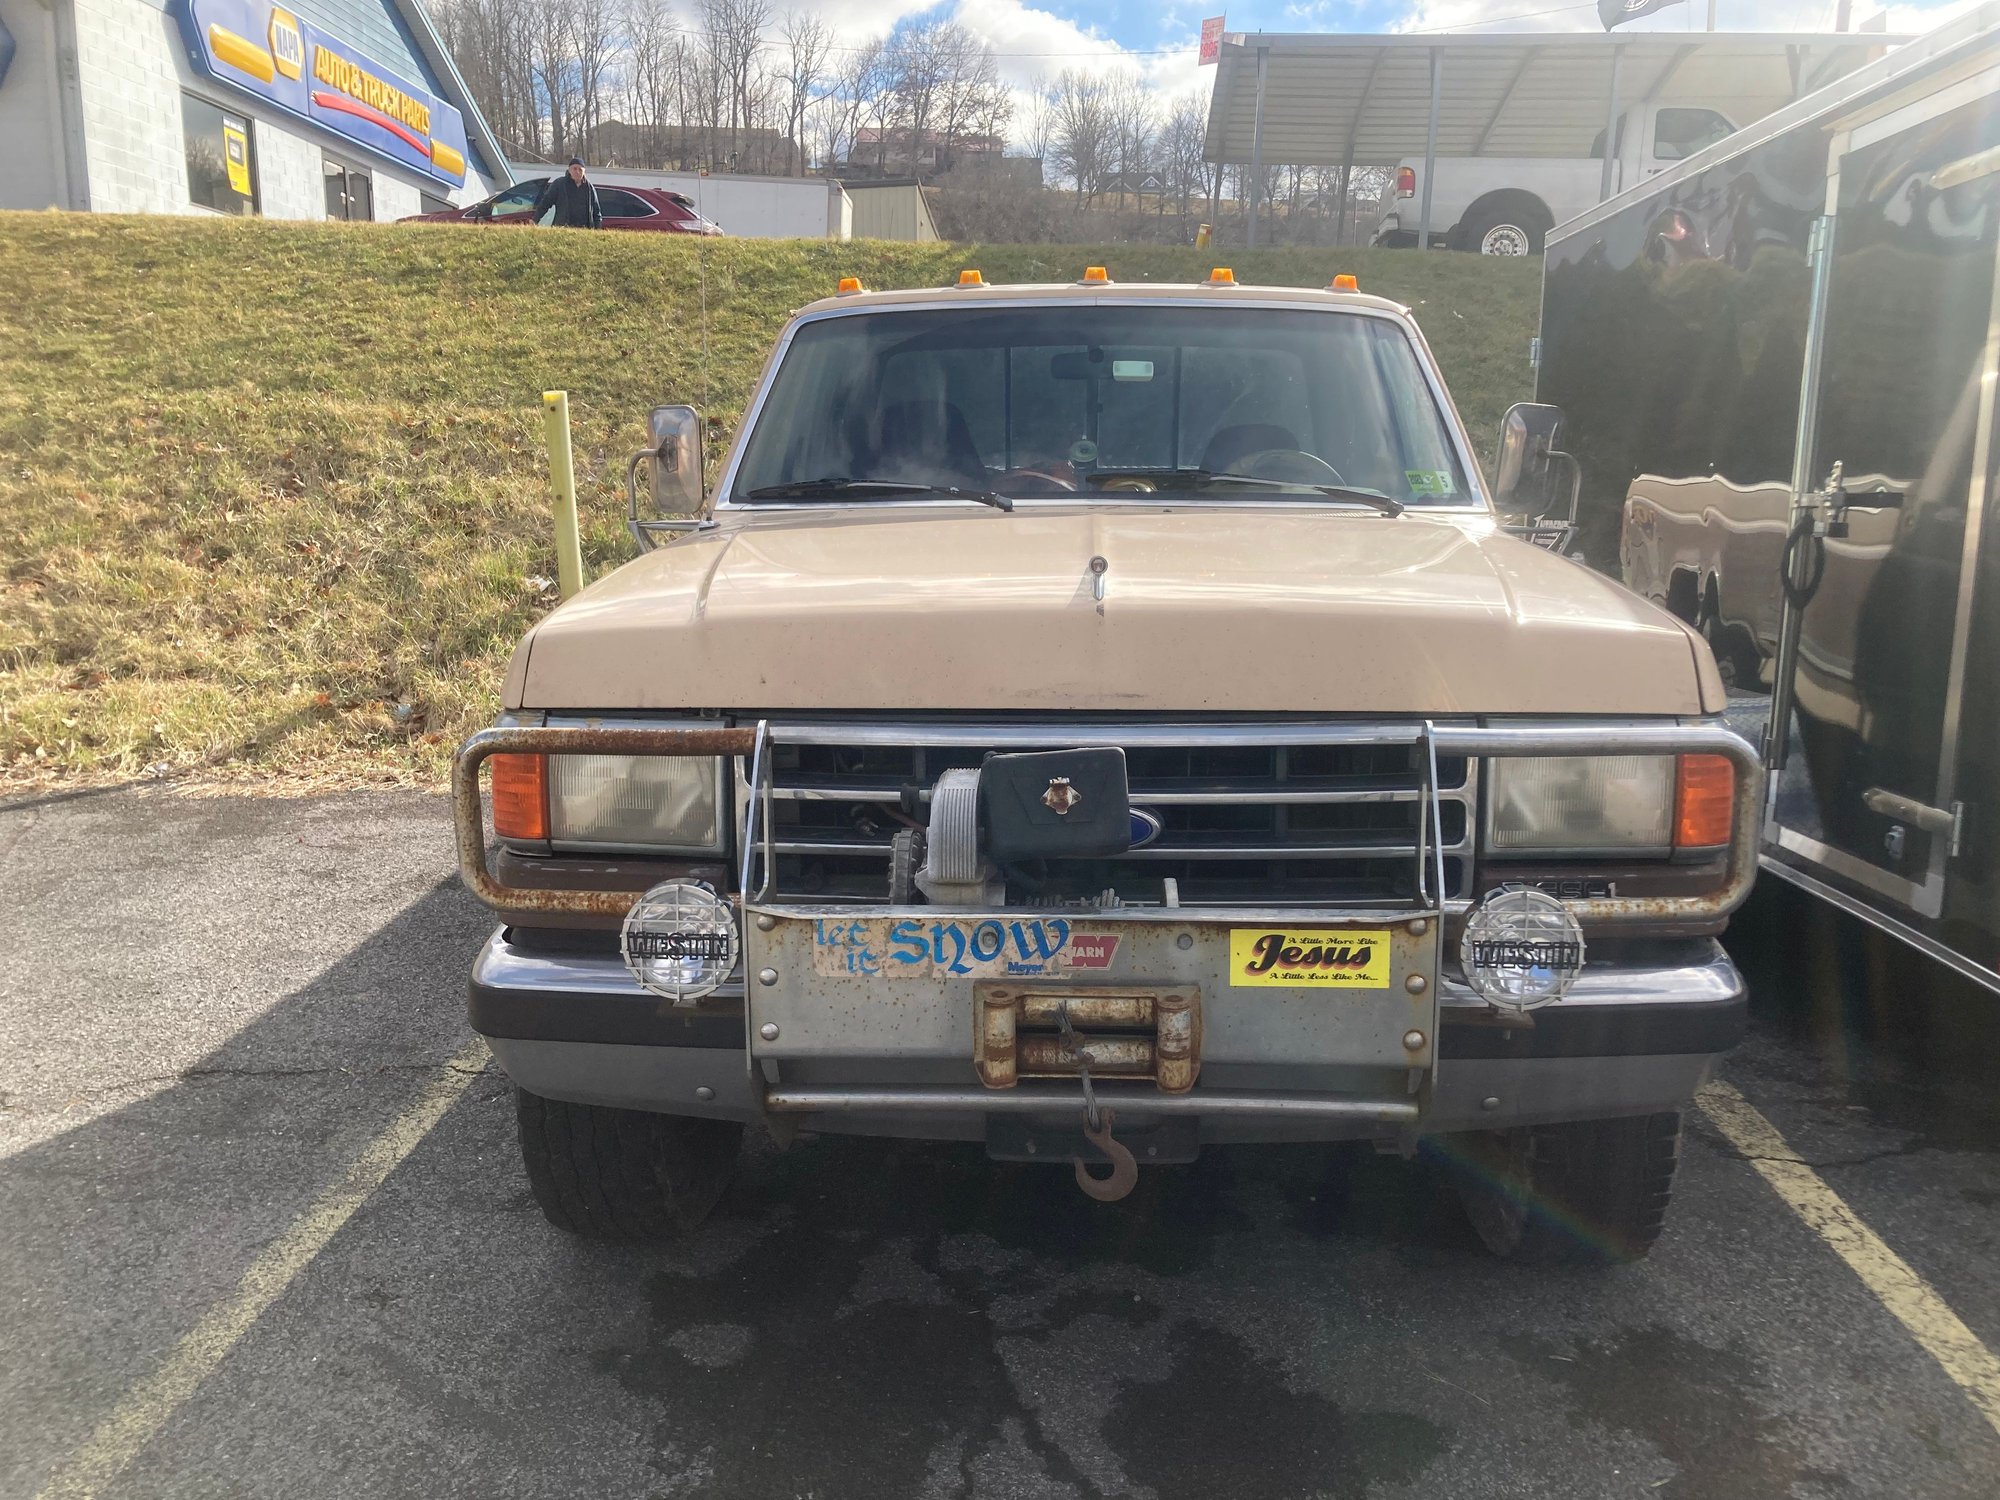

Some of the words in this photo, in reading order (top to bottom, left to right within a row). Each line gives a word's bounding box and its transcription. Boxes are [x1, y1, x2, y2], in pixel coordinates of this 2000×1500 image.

[274, 24, 301, 65] NAPA
[313, 45, 350, 93] AUTO
[361, 70, 402, 120] TRUCK
[400, 91, 431, 137] PARTS
[626, 931, 730, 961] WESTIN
[1246, 934, 1372, 973] Jesus
[1287, 937, 1297, 945] A
[1299, 937, 1324, 945] Little
[1326, 937, 1354, 945] More
[1356, 937, 1379, 946] Like
[1472, 940, 1581, 970] WESTIN
[1269, 972, 1279, 980] A
[1331, 973, 1353, 981] Like
